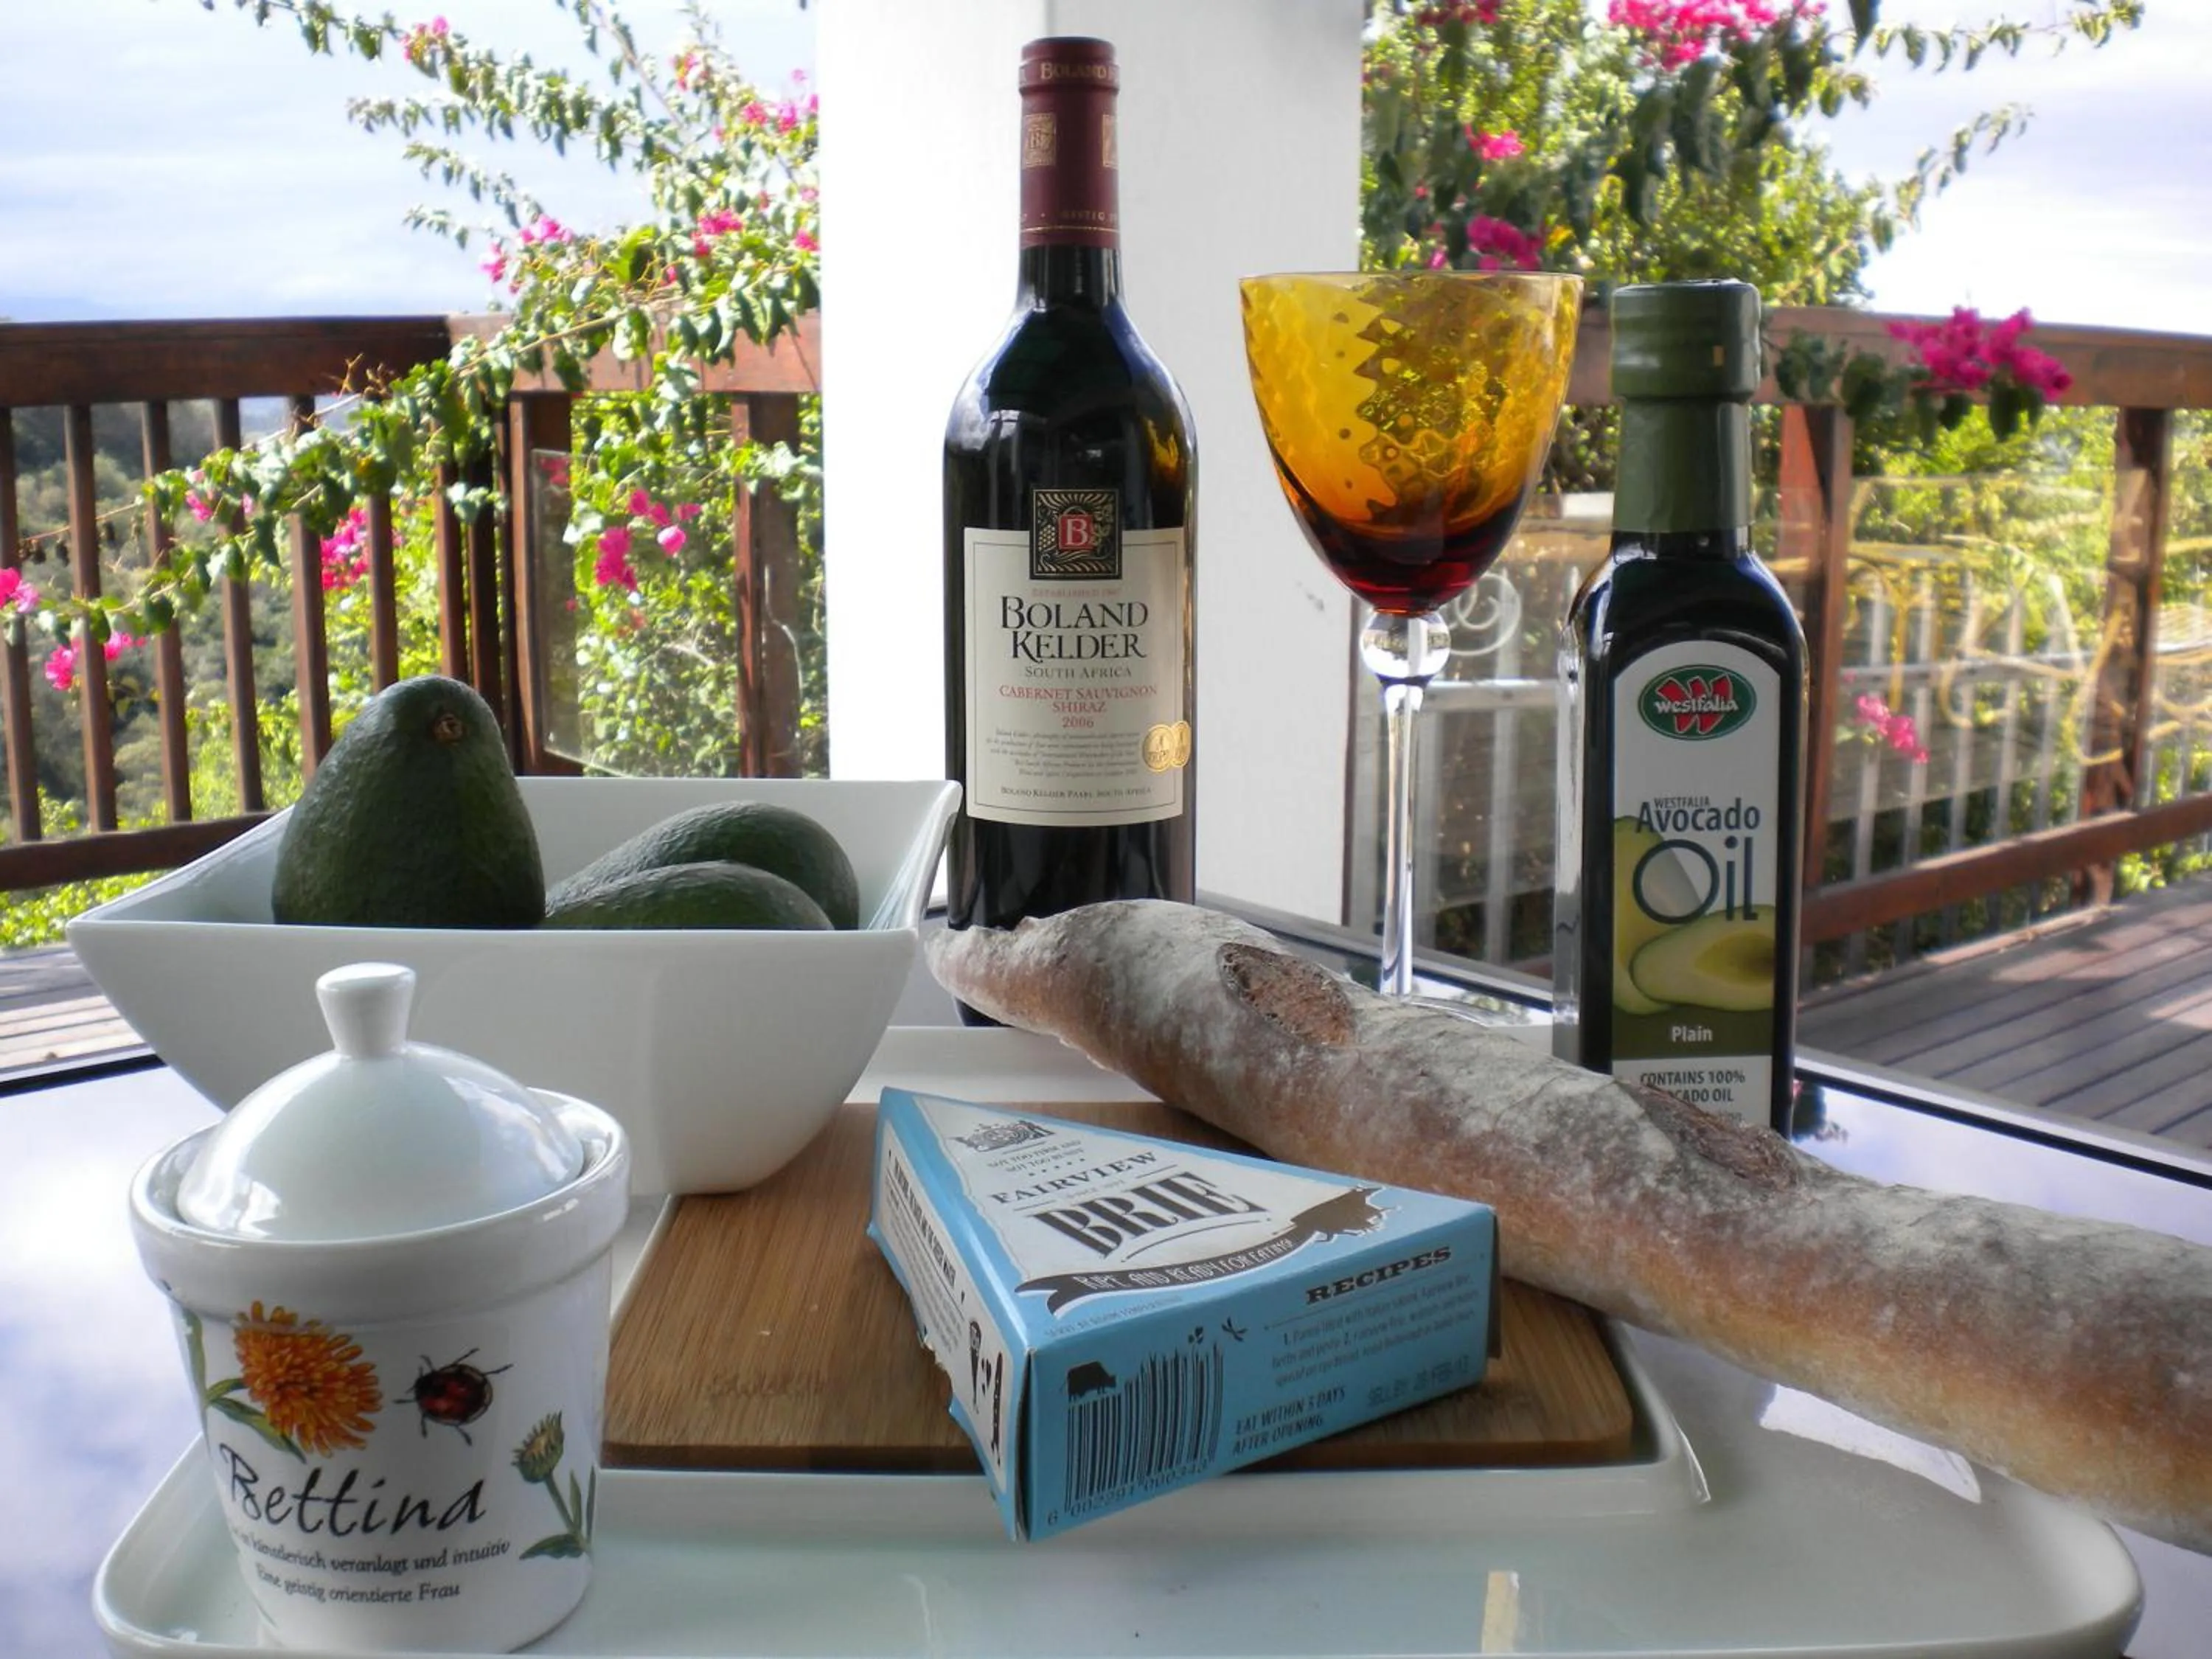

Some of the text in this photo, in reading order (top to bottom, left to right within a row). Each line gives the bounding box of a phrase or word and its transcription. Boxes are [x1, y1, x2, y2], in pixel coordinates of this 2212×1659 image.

[1065, 518, 1089, 546] B
[1001, 595, 1150, 630] BOLAND
[1012, 630, 1148, 664] KELDER
[1025, 666, 1133, 680] SOUTH AFRICA
[999, 684, 1158, 700] CABERNET SAUVIGNON
[1052, 701, 1106, 713] SHIRAZ
[1062, 716, 1094, 728] 2006
[1635, 797, 1761, 834] Avocado
[1654, 796, 1711, 810] WESTFALIA
[1632, 835, 1759, 925] Oil
[1672, 1026, 1714, 1042] Plain
[1640, 1069, 1746, 1087] CONTAINS 100%
[1712, 1086, 1734, 1102] OIL
[991, 1151, 1158, 1204] FAIRVIEW
[1027, 1171, 1270, 1259] BRIE
[1129, 1271, 1171, 1287] AND
[1305, 1246, 1453, 1305] RECIPES
[1261, 1399, 1304, 1427] WITHIN
[1316, 1386, 1346, 1408] DAYS
[1232, 1414, 1324, 1455] AFTER OPENING
[219, 1442, 487, 1537] Bettina
[330, 1554, 408, 1576] veranlagt
[413, 1548, 448, 1571] und
[453, 1538, 511, 1567] intuitiv
[329, 1587, 414, 1604] orientierte
[418, 1582, 462, 1602] Frau
